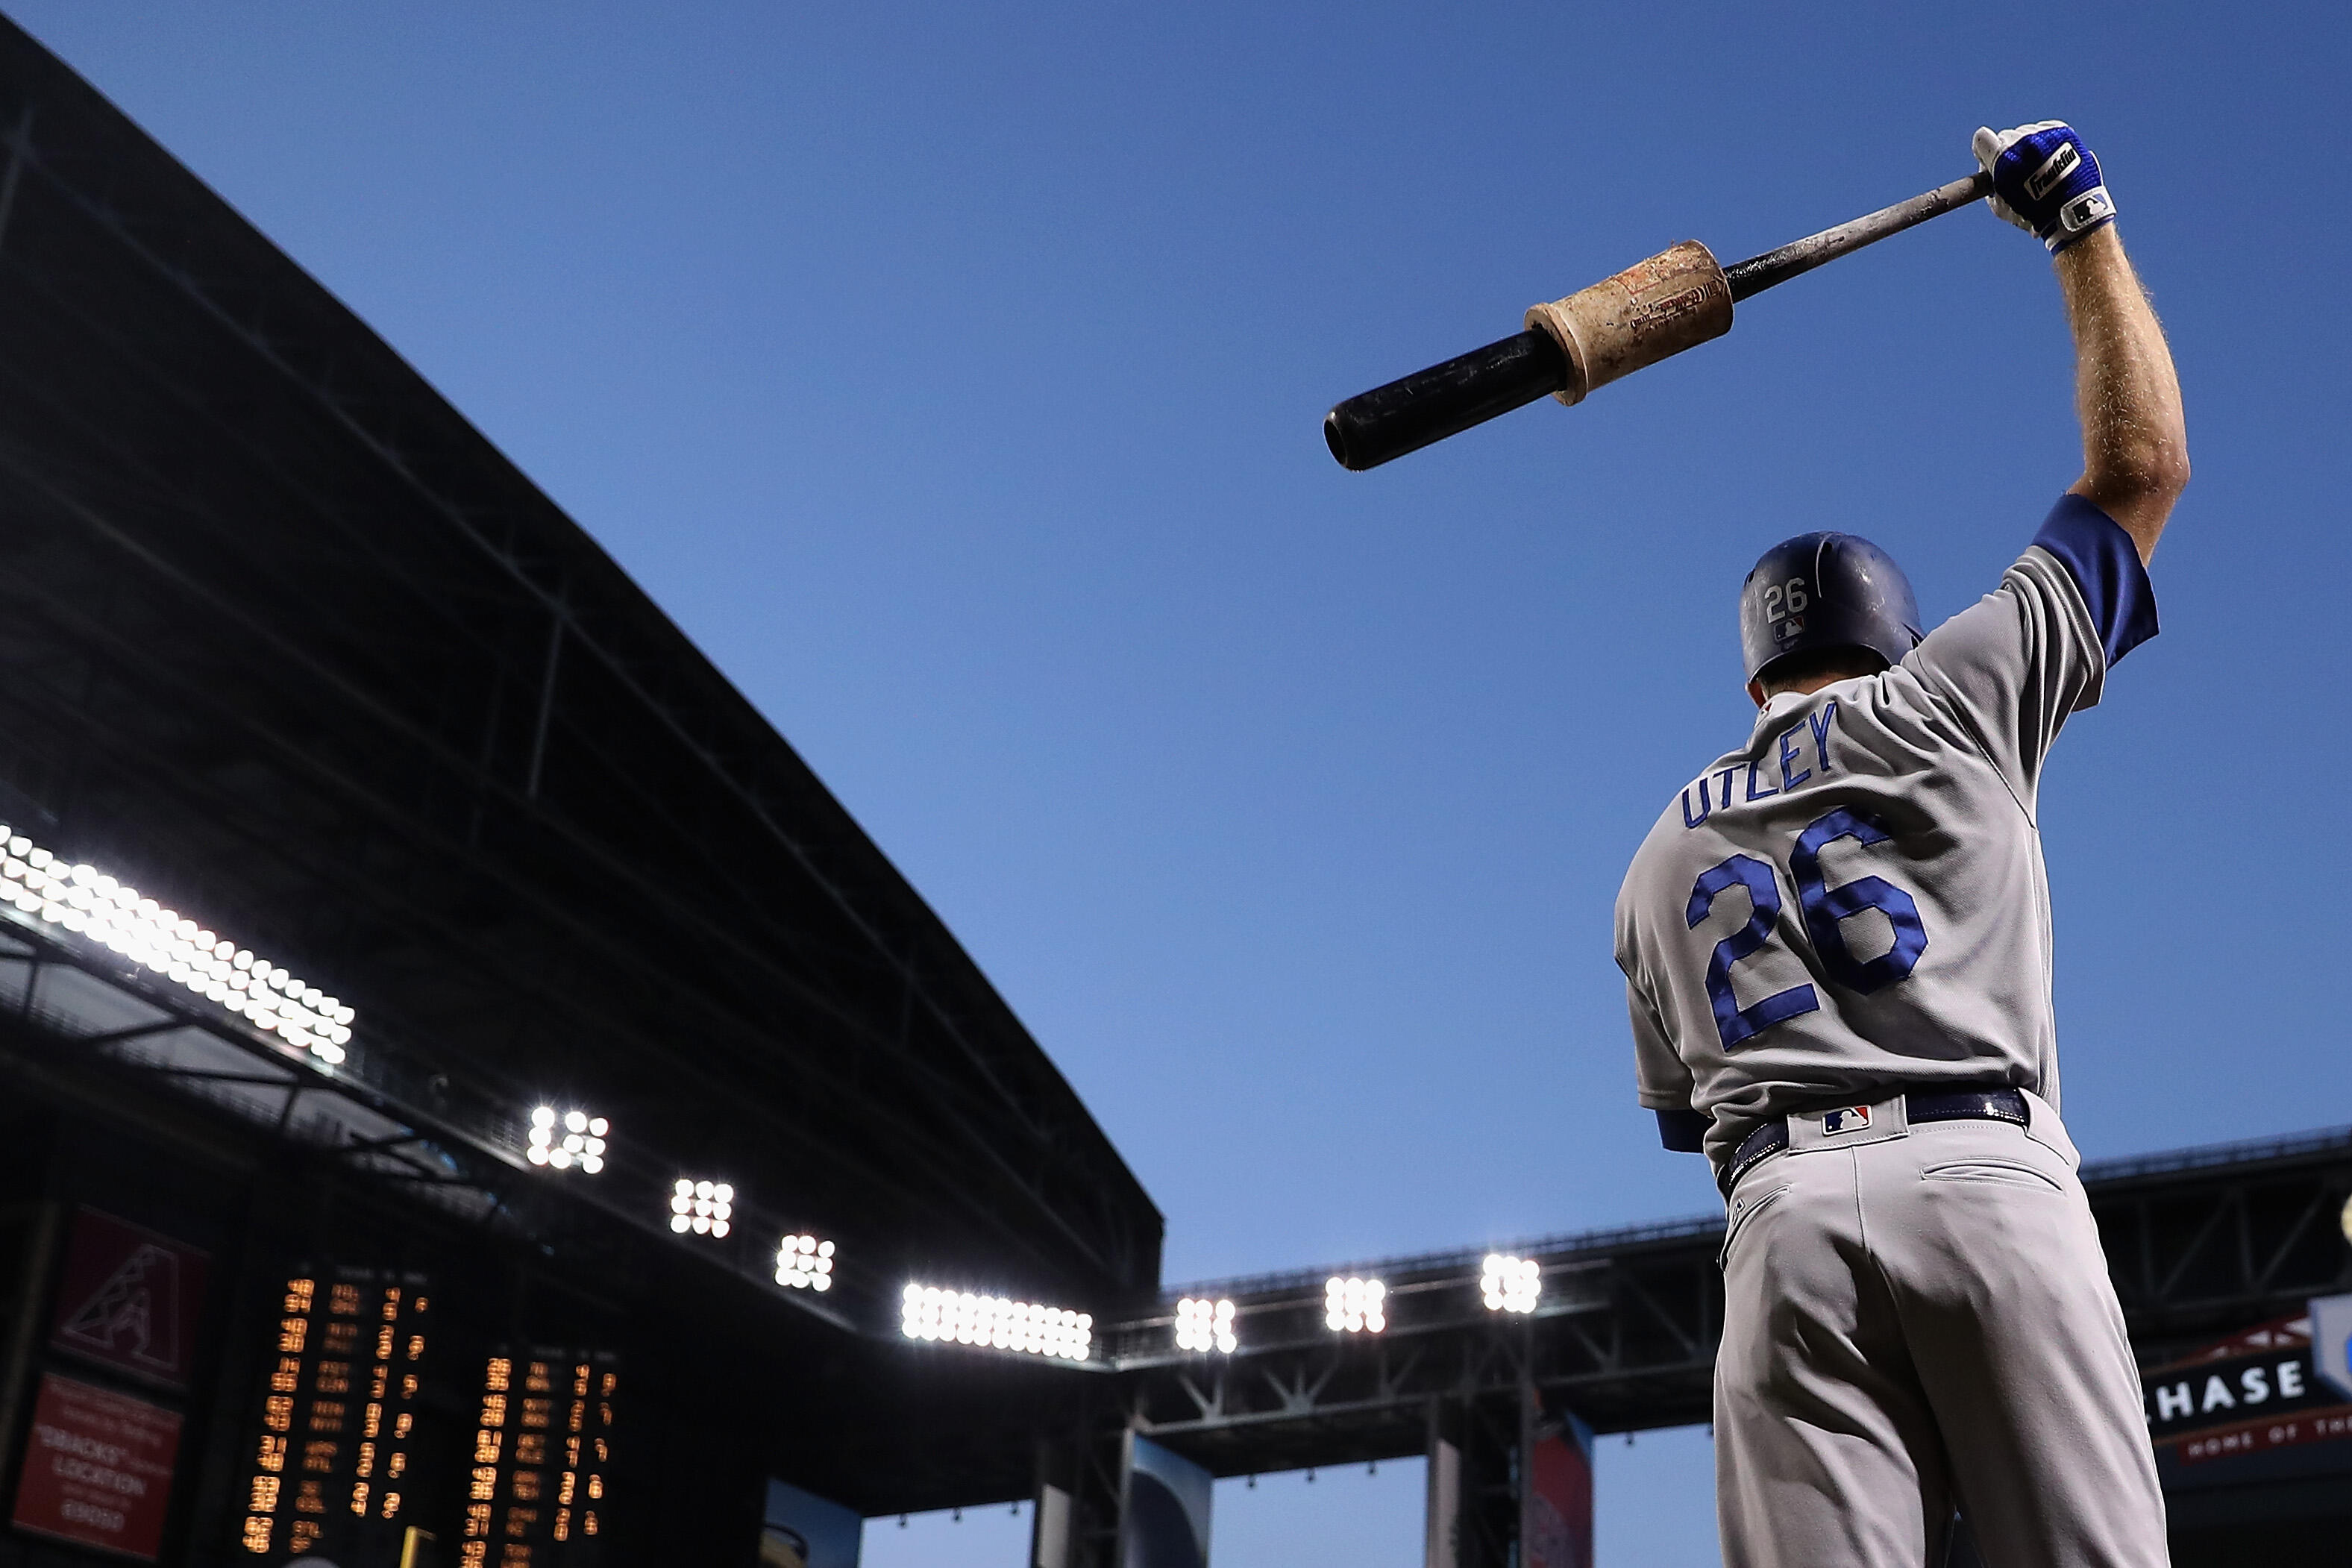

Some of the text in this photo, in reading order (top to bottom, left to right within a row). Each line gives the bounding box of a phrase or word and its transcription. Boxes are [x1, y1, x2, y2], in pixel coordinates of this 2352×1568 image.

[1764, 577, 1808, 624] 26
[1681, 700, 1838, 830] UTLEY
[1685, 805, 1929, 1053] 26
[2145, 1360, 2306, 1425] HASE
[2187, 1431, 2254, 1458] HOME
[2268, 1423, 2297, 1444] OF
